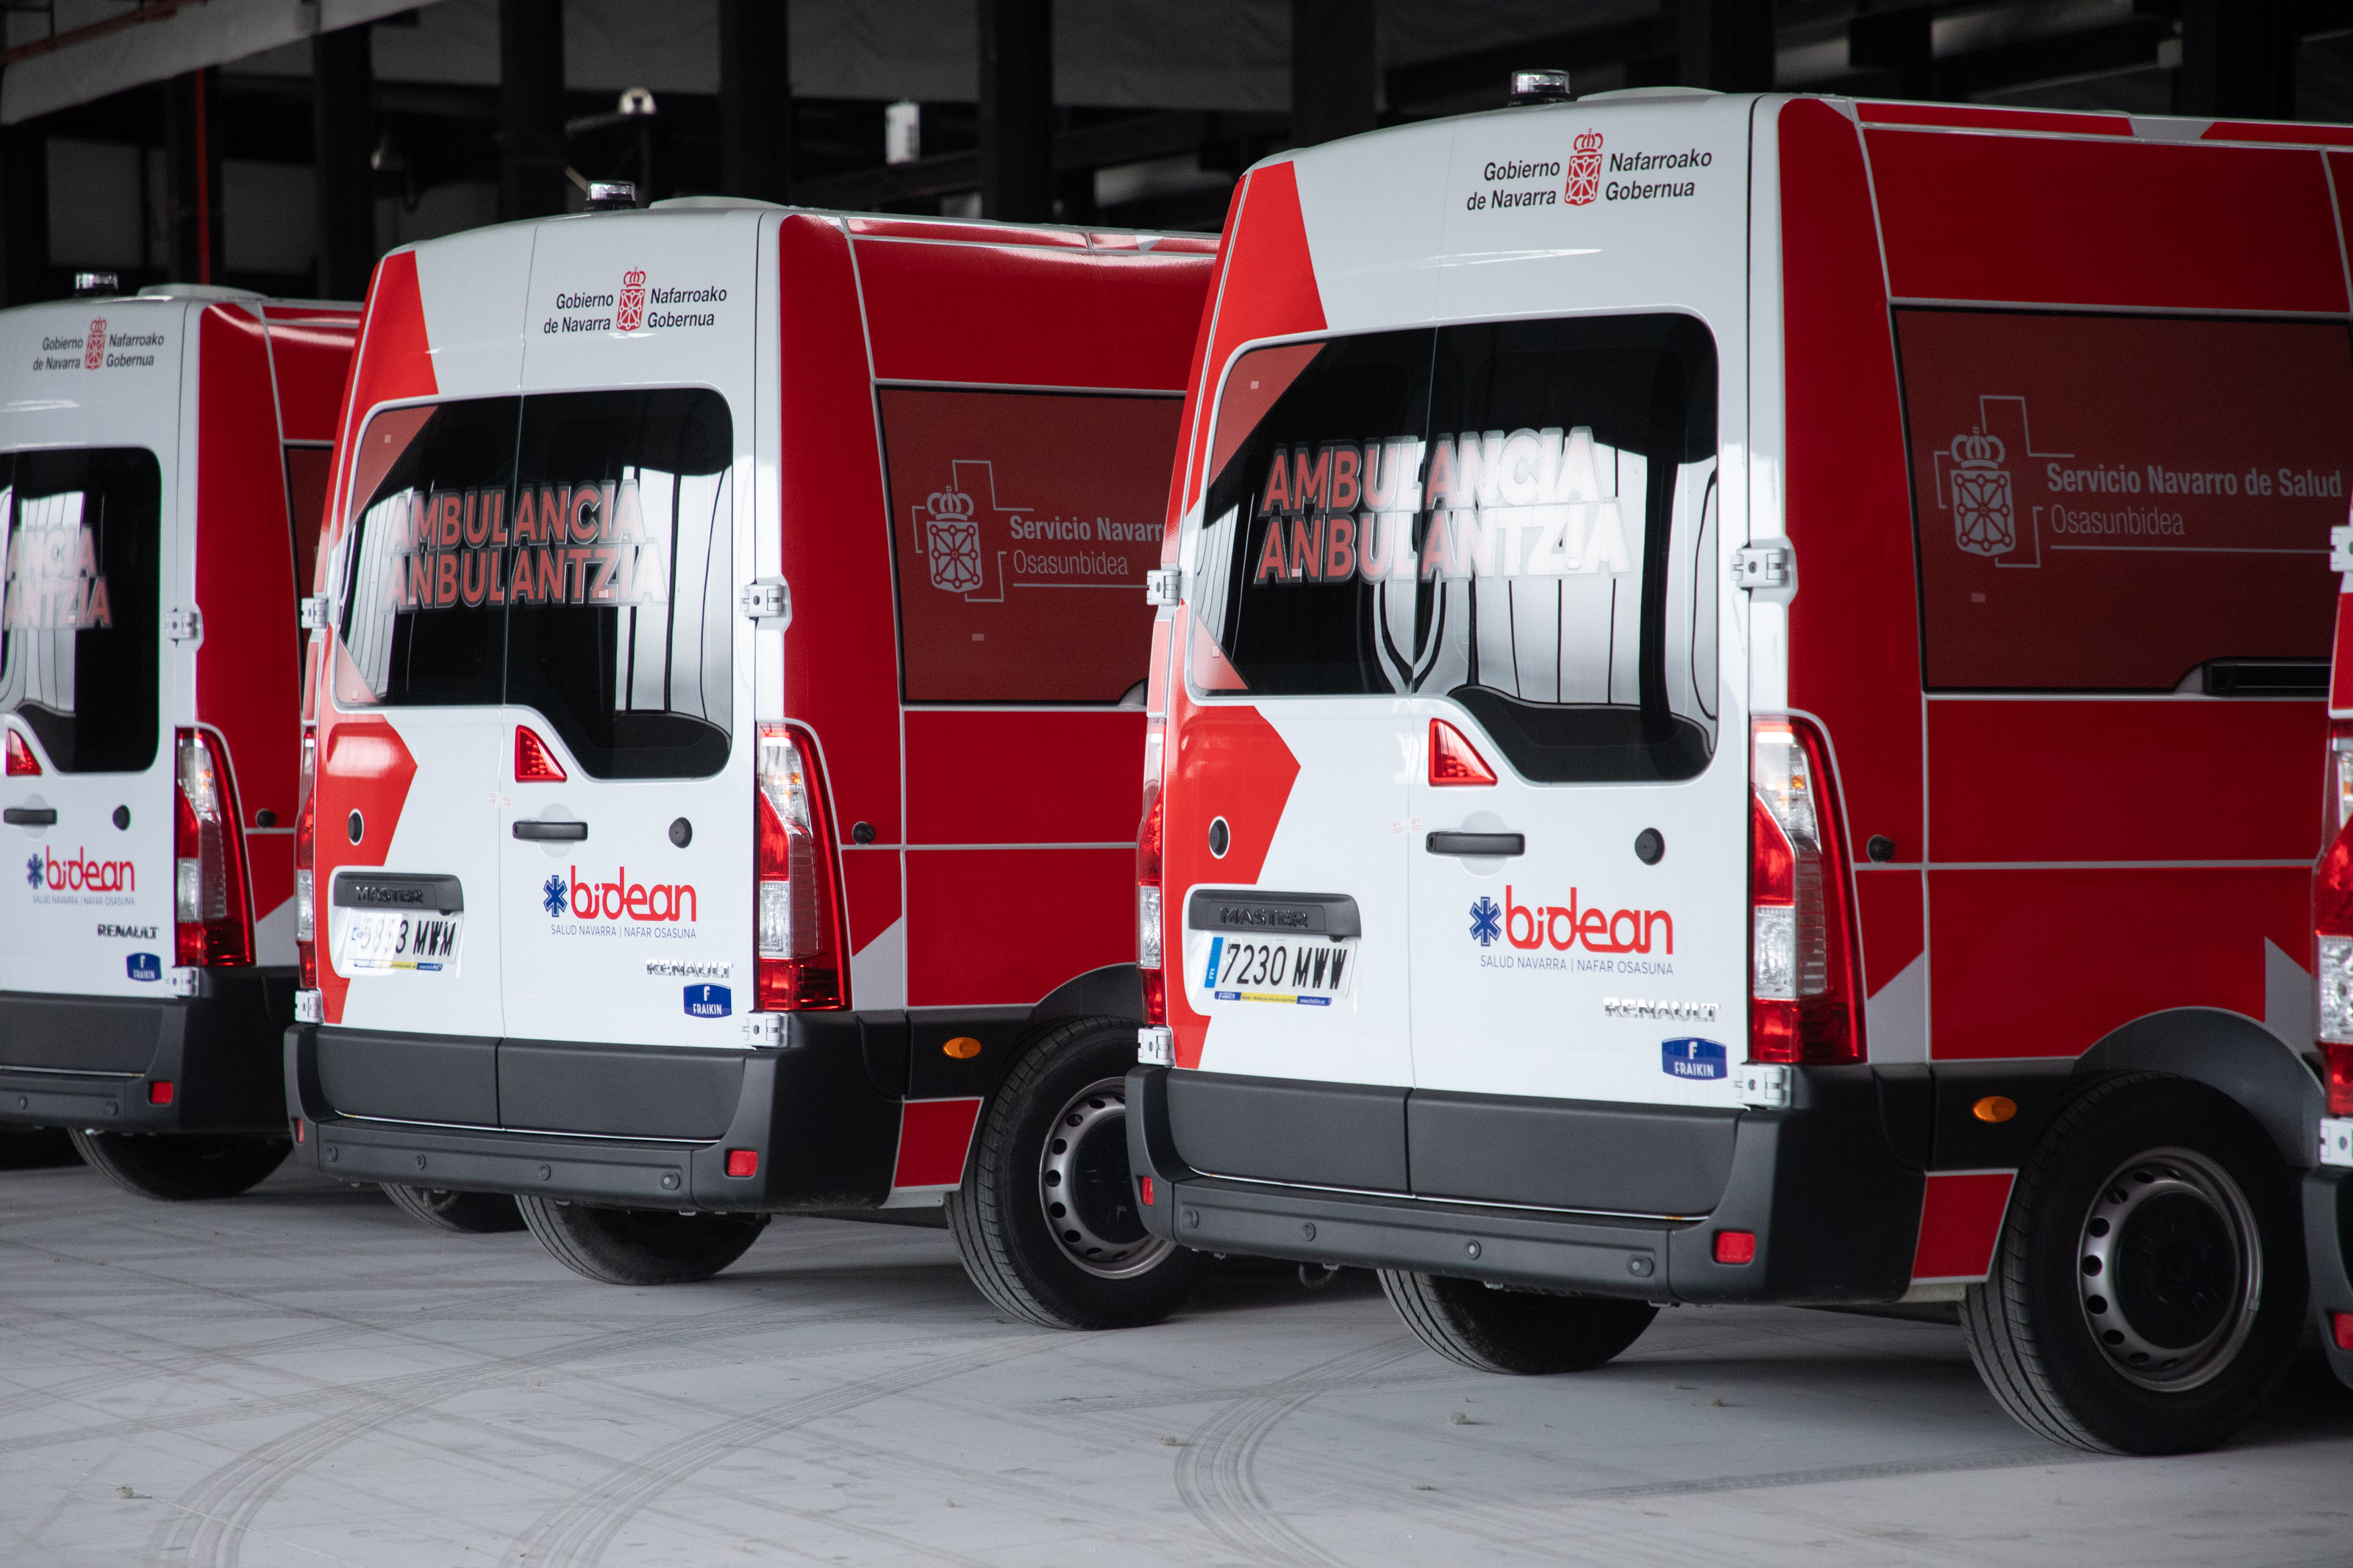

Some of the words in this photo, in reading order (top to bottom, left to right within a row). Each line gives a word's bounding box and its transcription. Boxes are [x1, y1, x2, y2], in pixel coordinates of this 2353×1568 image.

[1484, 160, 1560, 182] Gobierno
[1609, 148, 1713, 173] Nafarroako
[1467, 191, 1486, 211] de
[1491, 189, 1557, 209] Navarra
[1605, 180, 1696, 201] Gobernua
[556, 292, 614, 309] Gobierno
[650, 285, 727, 304] Nafarroako
[543, 318, 558, 334] de
[562, 316, 611, 333] Navarra
[648, 311, 715, 329] Gobernua
[43, 337, 84, 351] Gobierno
[109, 333, 165, 347] Nafarroako
[33, 357, 45, 371] de
[46, 356, 81, 371] Navarra
[107, 354, 155, 368] Gobernua
[1258, 426, 1602, 516] AMBULANCIA
[2046, 462, 2141, 494] Servicio
[2146, 465, 2238, 495] Navarro
[2244, 467, 2273, 497] de
[2278, 468, 2343, 498] Salud
[385, 479, 647, 557] AMBULANCIA
[1010, 515, 1091, 540] Servicio
[2050, 504, 2185, 537] Osasunbidea
[1253, 497, 1632, 585] ANBULANTZIA
[0, 523, 99, 581] ANCIA
[1013, 549, 1129, 576] Osasunbidea
[382, 537, 668, 615] ANBULANTZIA
[0, 573, 113, 631] ANTZIA
[46, 845, 135, 892] bidean
[32, 895, 51, 905] SALUD
[52, 895, 78, 906] NAVARRA
[84, 896, 103, 906] NAFAR
[105, 896, 135, 906] OSASUNA
[355, 886, 423, 904] MASTER
[571, 865, 696, 922] bidean
[1220, 907, 1307, 928] MASTER
[1506, 885, 1673, 955] bidean
[98, 924, 159, 939] RENAULT
[413, 920, 457, 957] MWM
[551, 924, 577, 936] SALUD
[579, 925, 616, 937] NAVARRA
[624, 926, 651, 938] NAFAR
[654, 928, 696, 939] OSASUNA
[133, 969, 155, 979] FRAIKIN
[646, 959, 734, 978] RENAULT
[1209, 967, 1215, 980] E
[1221, 943, 1287, 987] 7230
[1292, 946, 1347, 989] MWW
[1480, 955, 1514, 968] SALUD
[1518, 956, 1567, 970] NAVARRA
[1577, 959, 1614, 973] NAFAR
[1618, 961, 1674, 975] OSASUNA
[693, 1003, 722, 1015] FRAIKIN
[1603, 998, 1721, 1023] RENAULT
[1674, 1062, 1715, 1078] FRAIKIN
